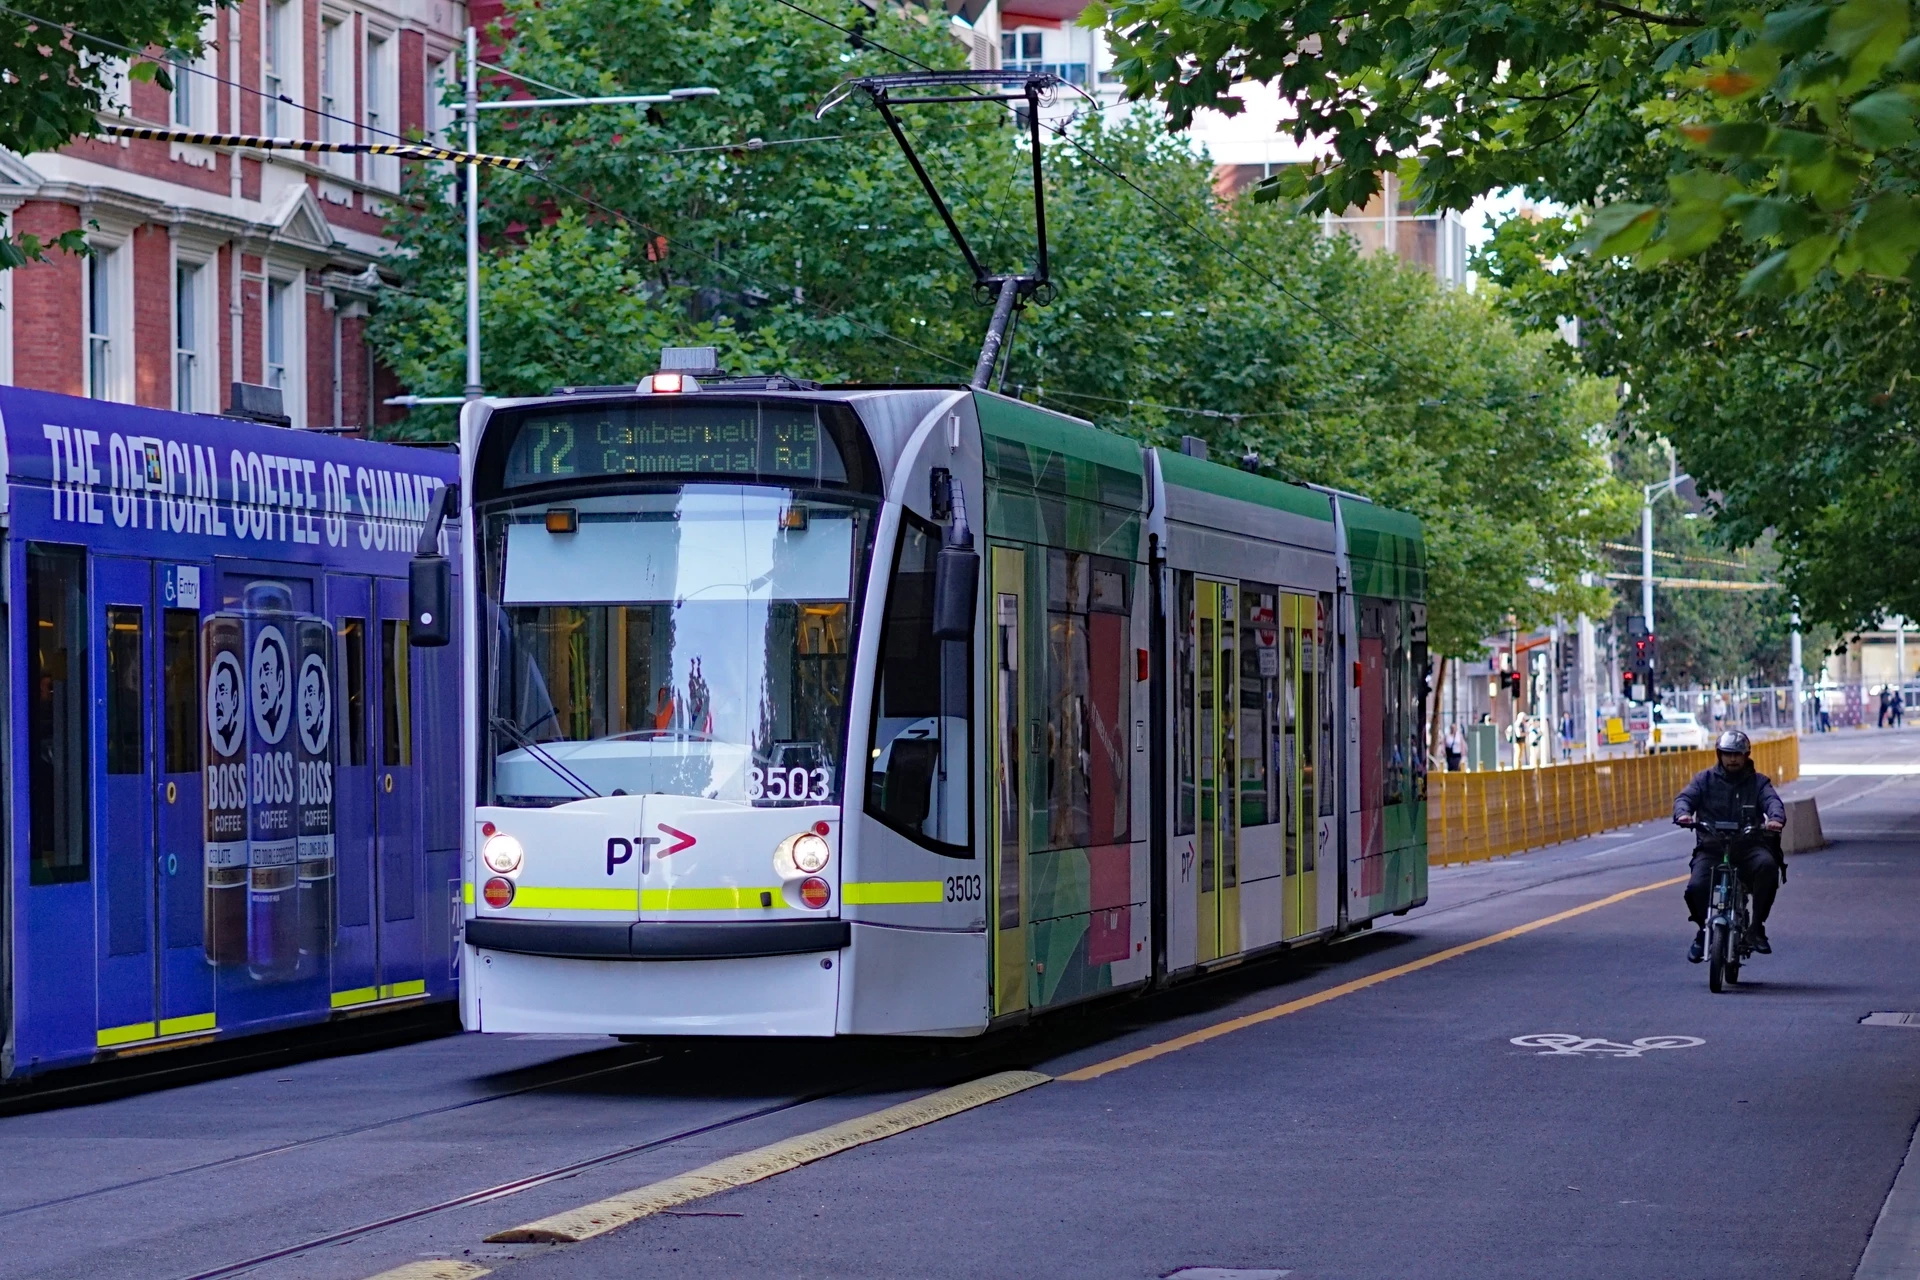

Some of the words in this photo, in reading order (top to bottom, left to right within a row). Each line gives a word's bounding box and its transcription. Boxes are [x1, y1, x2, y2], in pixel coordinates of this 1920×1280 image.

[598, 419, 757, 444] Camberwell
[775, 418, 816, 442] via
[527, 422, 574, 473] 72
[603, 448, 757, 473] Commercial
[775, 446, 811, 471] Rd
[43, 423, 104, 525] THE
[230, 448, 320, 545] COFFEE
[323, 460, 352, 548] OF
[179, 577, 199, 600] Entry
[208, 763, 247, 810] BOSS
[252, 751, 294, 805] BOSS
[299, 760, 332, 806] BOSS
[744, 767, 830, 801] 3503
[214, 815, 242, 833] COFFEE
[260, 810, 289, 830] COFFEE
[304, 810, 328, 827] COFFEE
[946, 874, 982, 903] 3503
